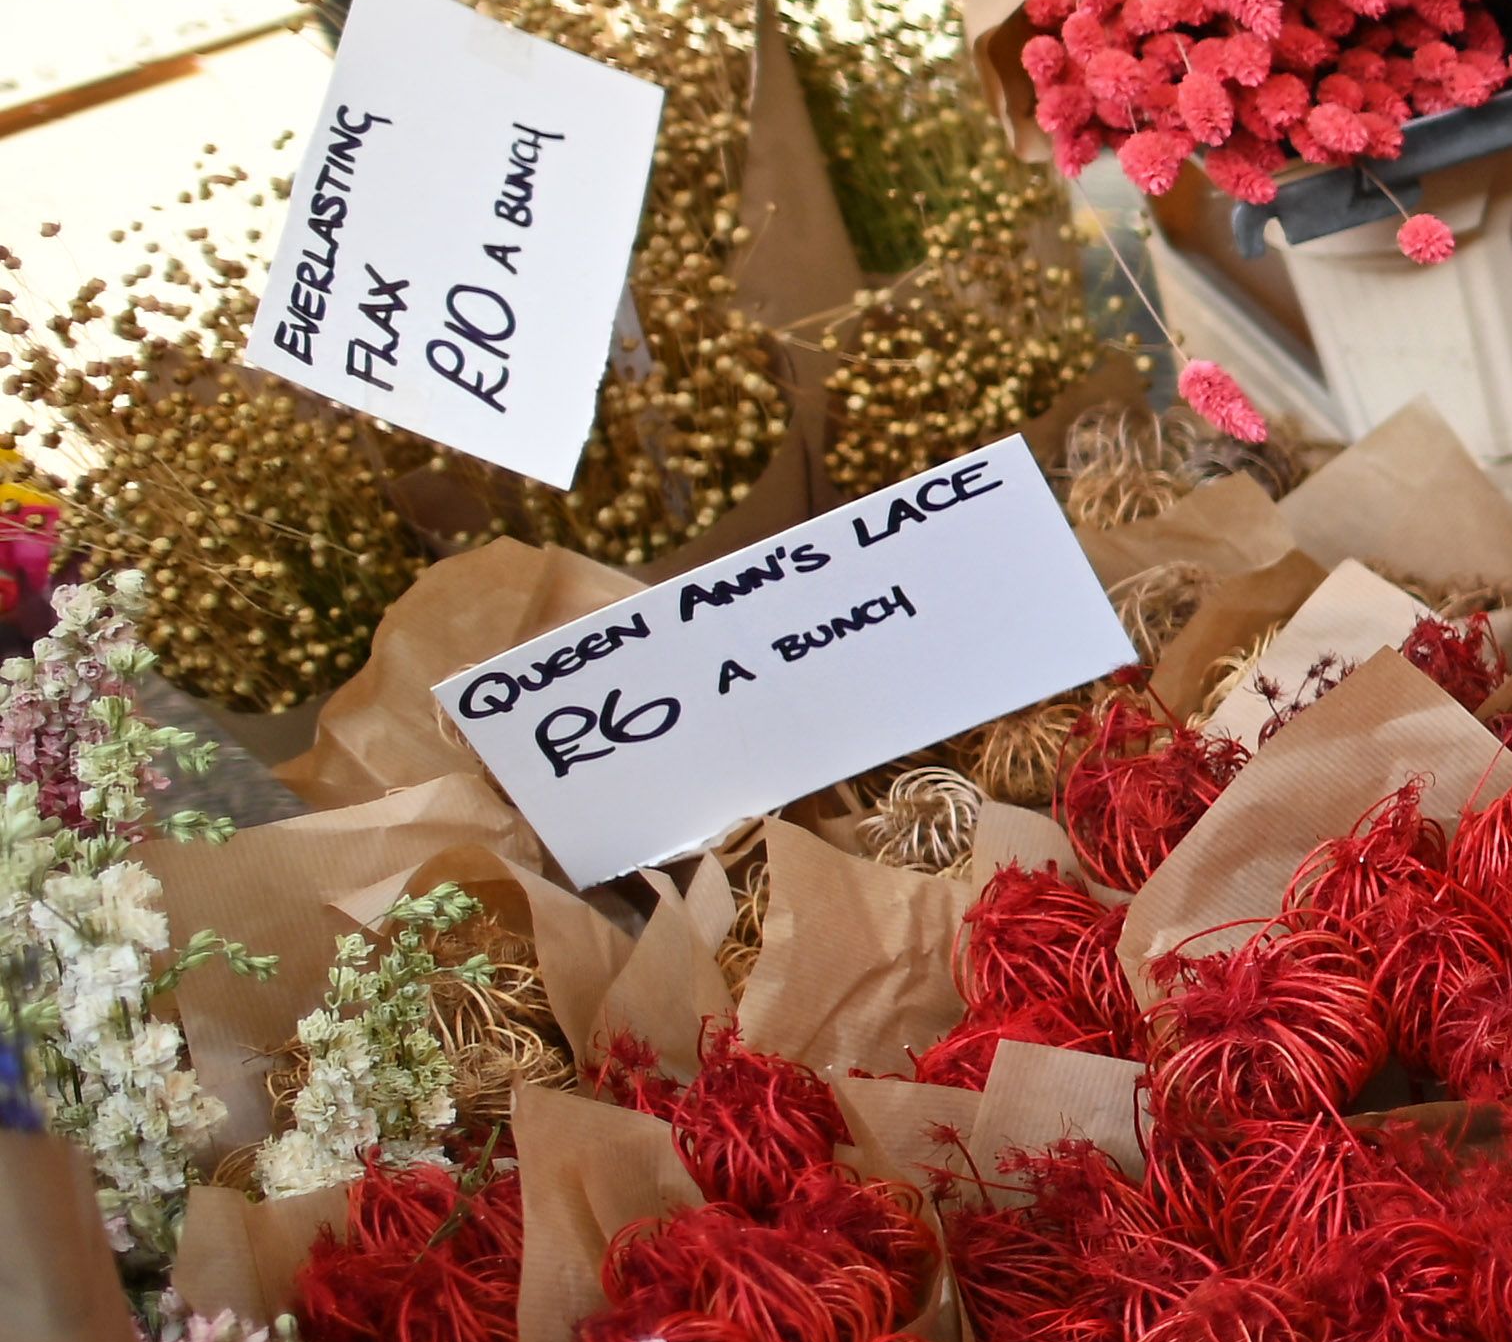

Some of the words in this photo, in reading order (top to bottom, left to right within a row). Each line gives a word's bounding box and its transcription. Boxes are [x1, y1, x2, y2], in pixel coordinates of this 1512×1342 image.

[273, 104, 393, 366] EVERLASTING
[494, 122, 566, 228] BUNCH
[482, 243, 522, 275] A
[346, 262, 410, 392] FLAX
[425, 283, 517, 414] £10
[458, 612, 651, 719] QUEEN
[679, 543, 832, 622] ANN'S
[852, 461, 1004, 548] LACE
[534, 688, 681, 777] £6
[718, 659, 756, 695] A
[771, 585, 917, 662] BUNCH
